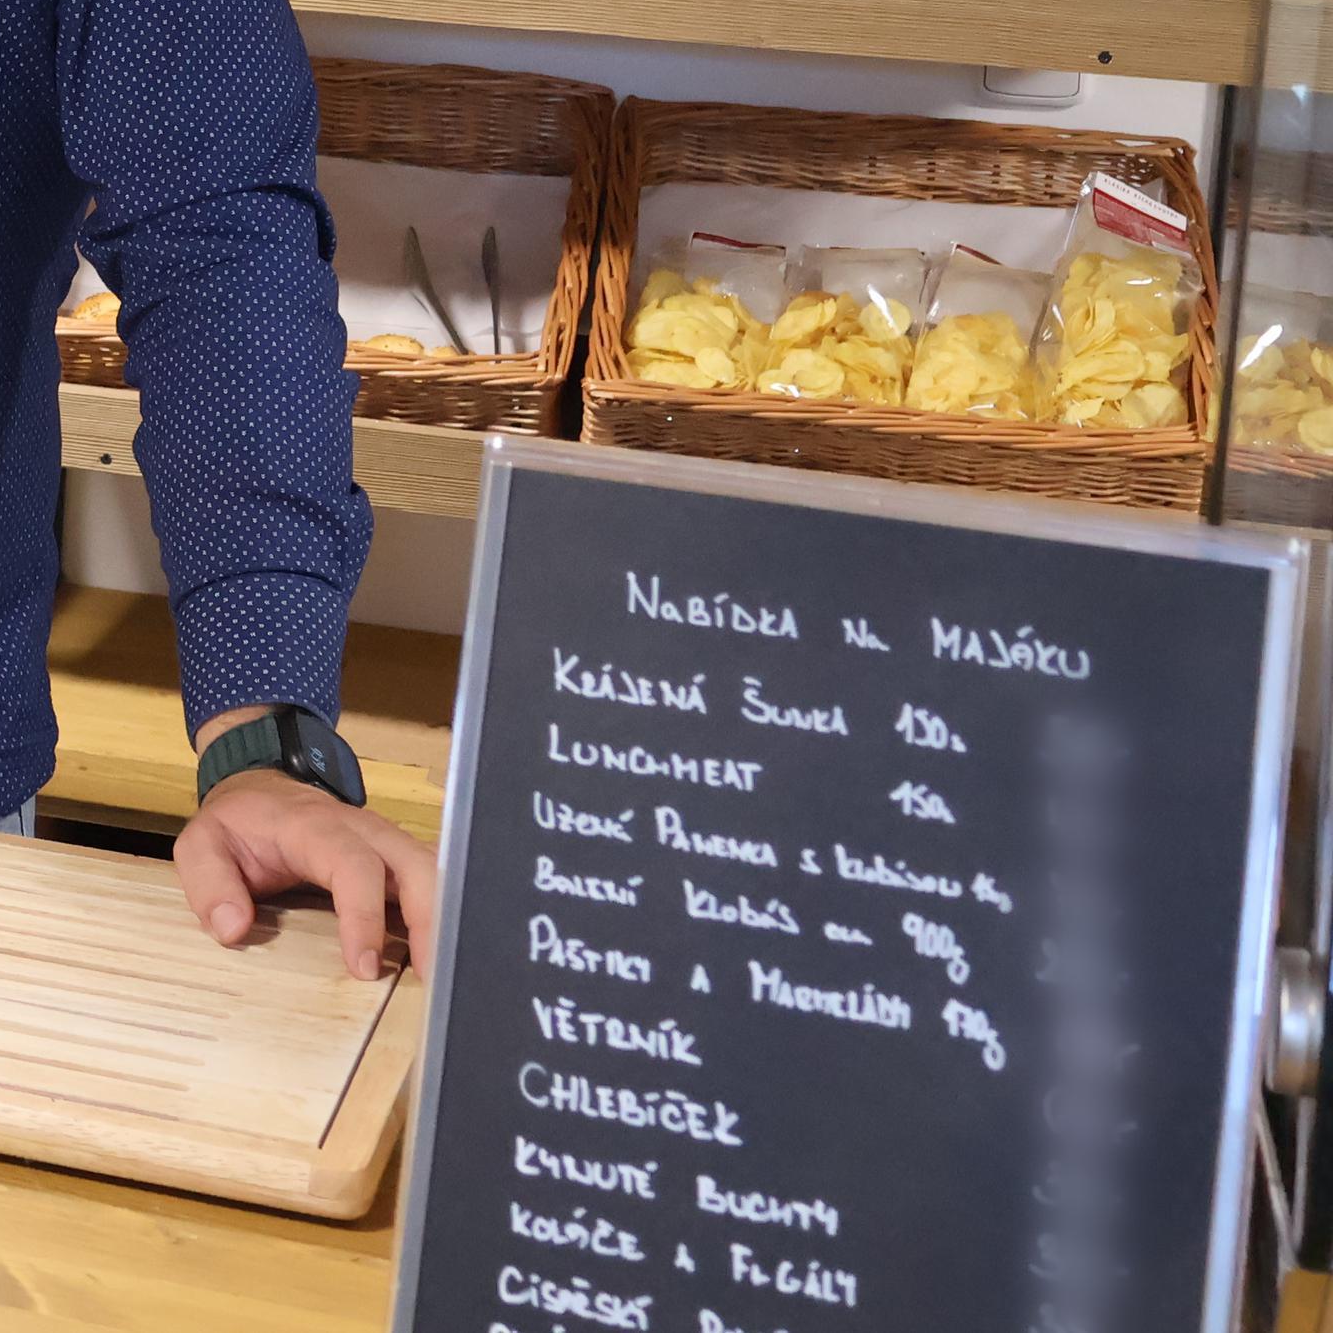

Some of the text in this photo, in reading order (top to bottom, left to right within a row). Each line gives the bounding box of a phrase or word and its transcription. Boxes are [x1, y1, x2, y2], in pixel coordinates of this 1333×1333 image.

[901, 911, 971, 986] 900g
[532, 996, 703, 1067] VĚTRNÍK
[518, 1061, 745, 1147] CHLEBÍČEK
[695, 1173, 840, 1237] BUCHTY
